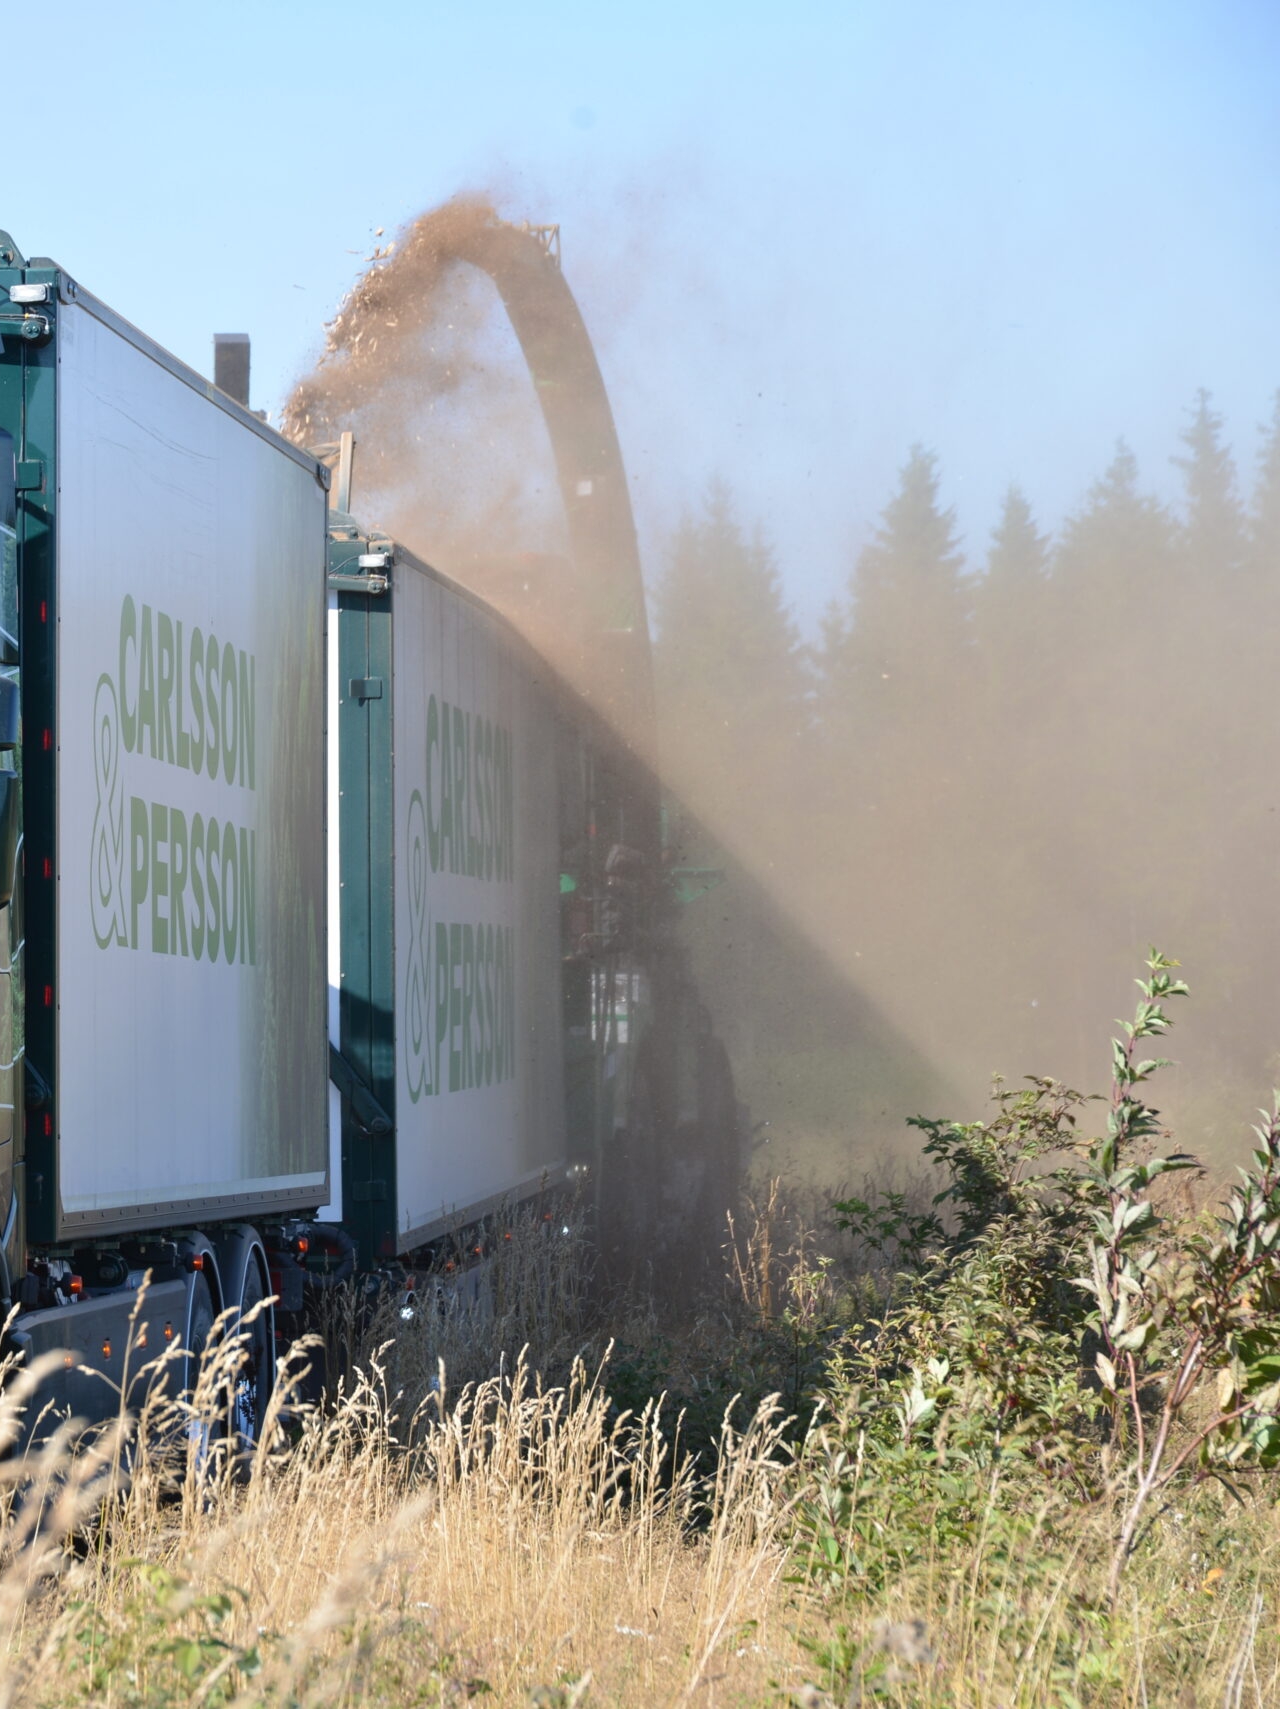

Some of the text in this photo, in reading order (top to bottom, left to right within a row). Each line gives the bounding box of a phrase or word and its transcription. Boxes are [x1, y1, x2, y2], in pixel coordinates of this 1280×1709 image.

[120, 593, 256, 792] CARLSSON
[425, 693, 515, 884] CARLSSON
[89, 672, 257, 967] & PERSSON
[404, 788, 516, 1105] & PERSSON
